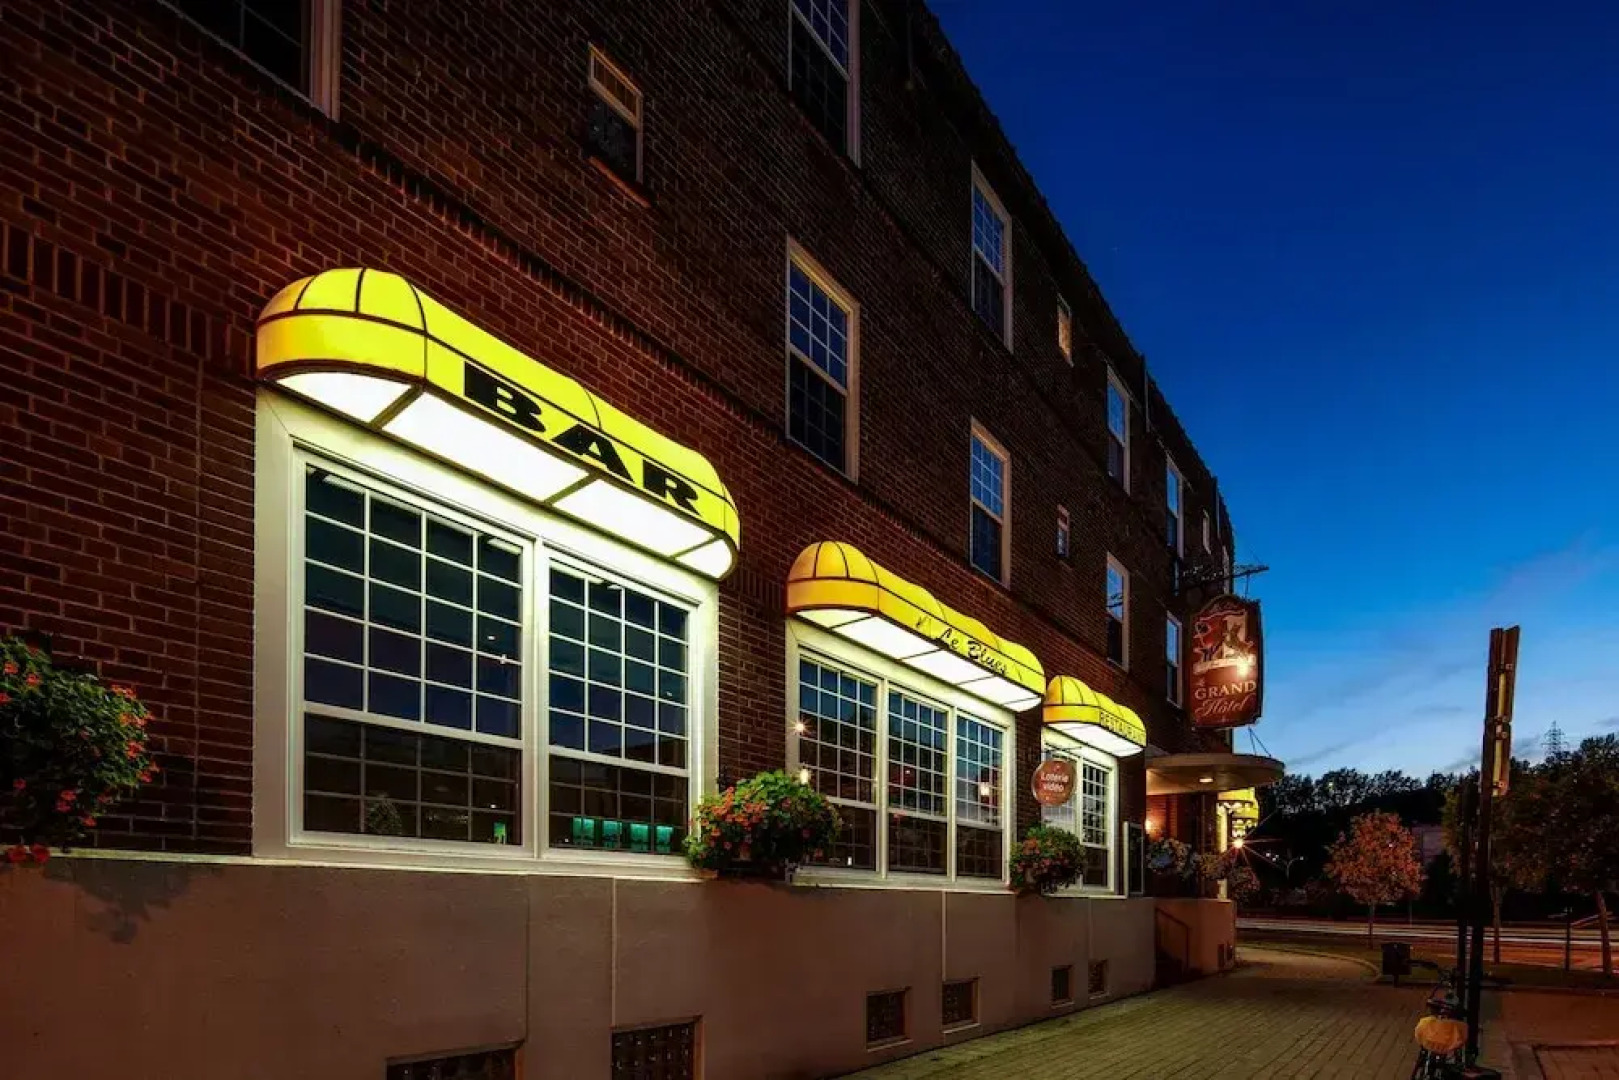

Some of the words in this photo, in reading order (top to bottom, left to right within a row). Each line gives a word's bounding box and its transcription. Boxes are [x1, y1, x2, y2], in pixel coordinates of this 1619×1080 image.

[463, 361, 702, 517] BAR
[939, 627, 959, 650] Le
[967, 640, 1009, 676] Blues
[1194, 680, 1257, 700] GRAND
